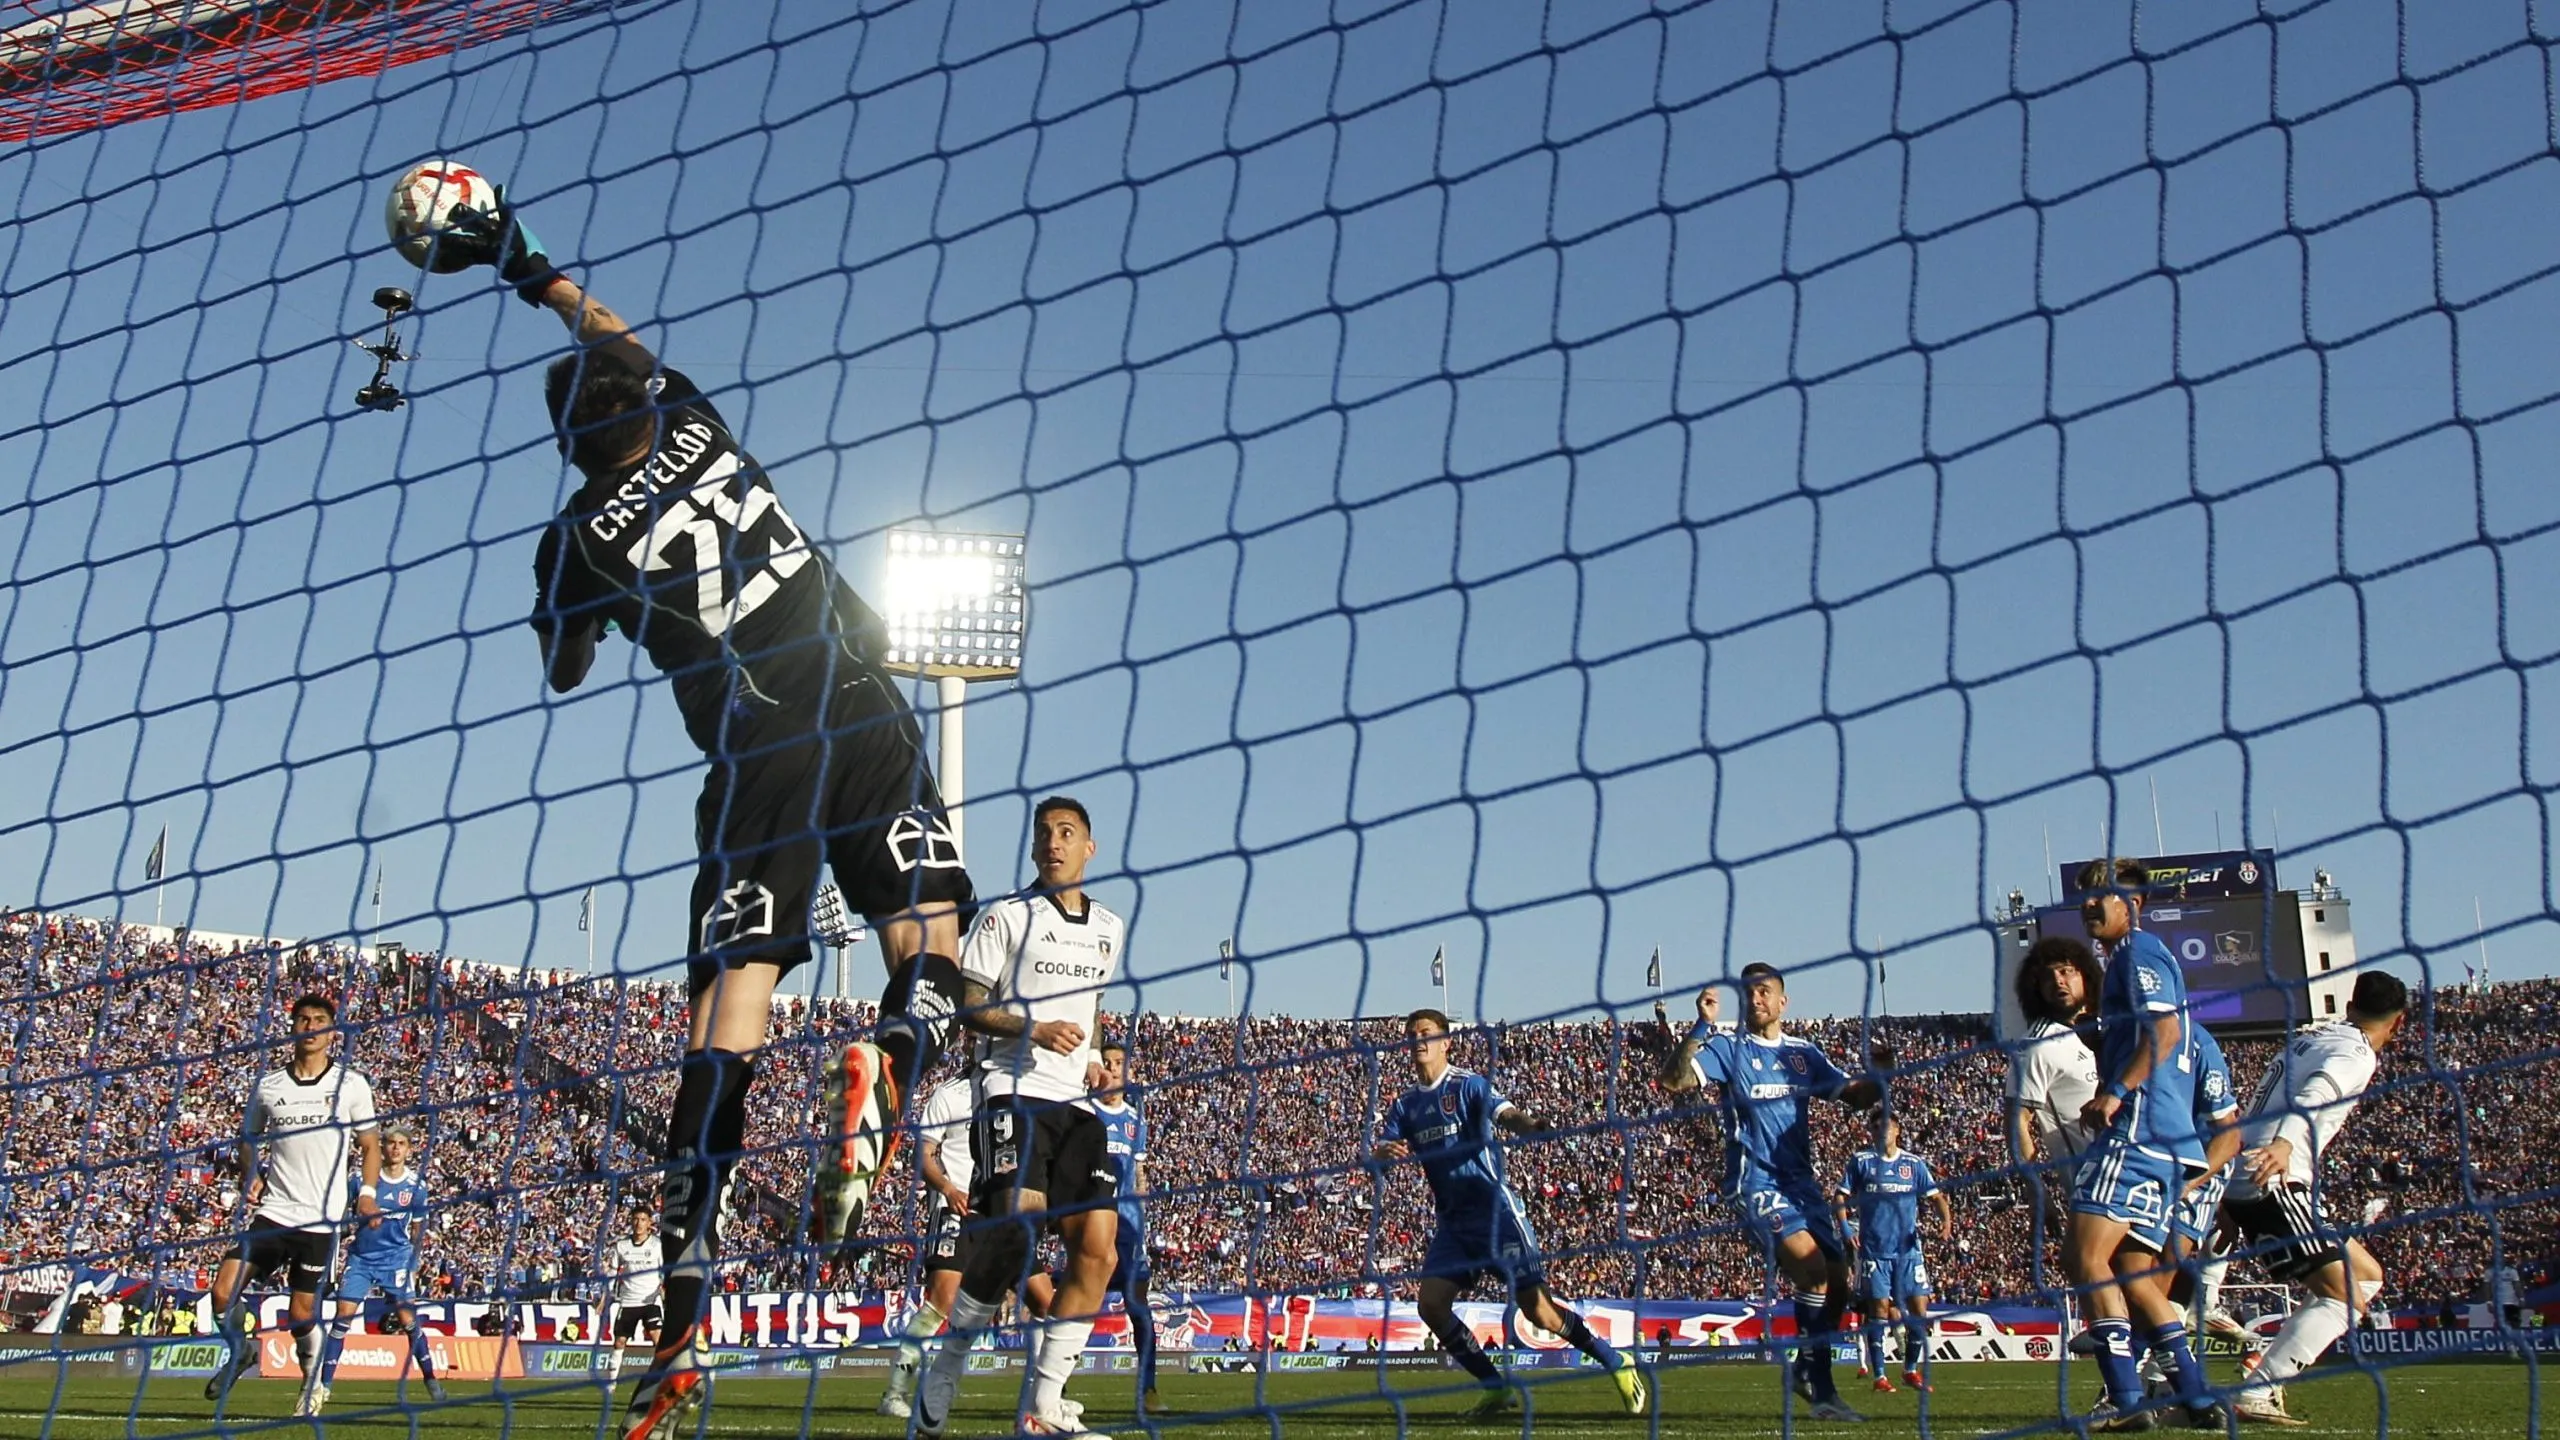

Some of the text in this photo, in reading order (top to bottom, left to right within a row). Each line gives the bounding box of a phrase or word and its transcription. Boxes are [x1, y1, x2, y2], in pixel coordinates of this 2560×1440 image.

[1034, 961, 1097, 979] COOLBET
[993, 1109, 1014, 1143] 9
[1753, 1190, 1789, 1216] 22
[1356, 1357, 1411, 1365] PATRONADOR
